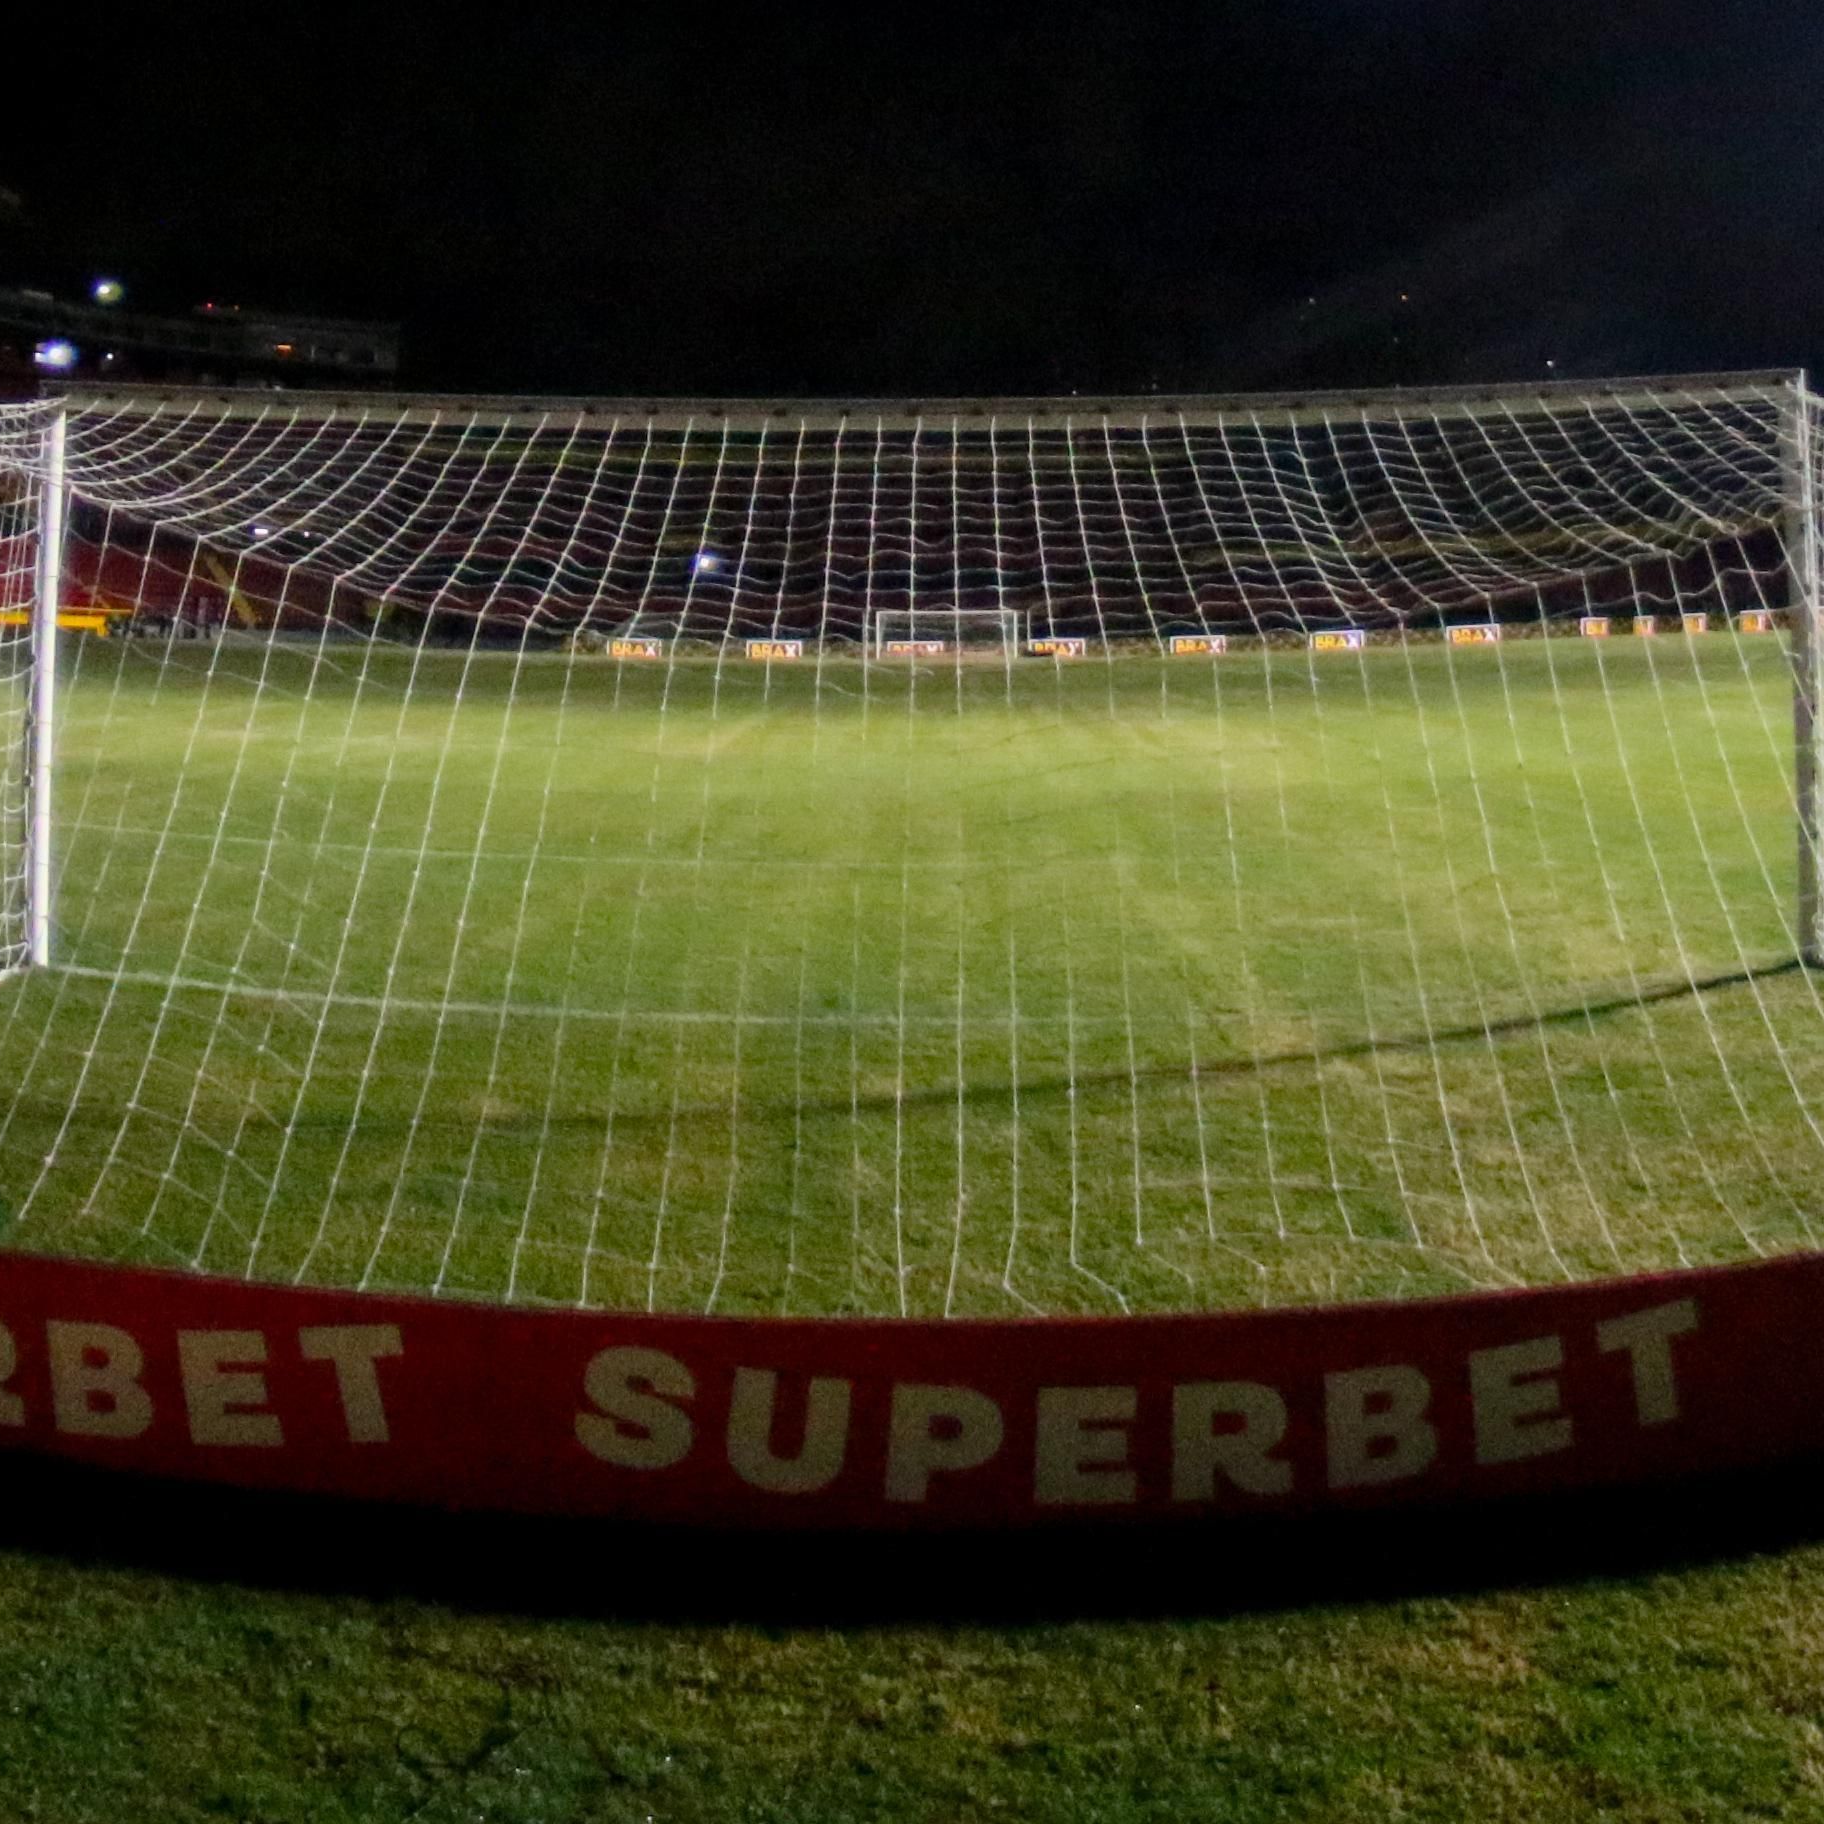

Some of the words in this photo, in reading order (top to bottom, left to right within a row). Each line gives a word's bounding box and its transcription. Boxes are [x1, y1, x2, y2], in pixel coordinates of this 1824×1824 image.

[1315, 633, 1360, 651] BRAX
[1451, 627, 1498, 645] BRAX
[612, 641, 657, 659] BRAX
[751, 642, 798, 659] BRAX
[1176, 639, 1220, 654] BRAX
[576, 1300, 1700, 1506] SUPERBET
